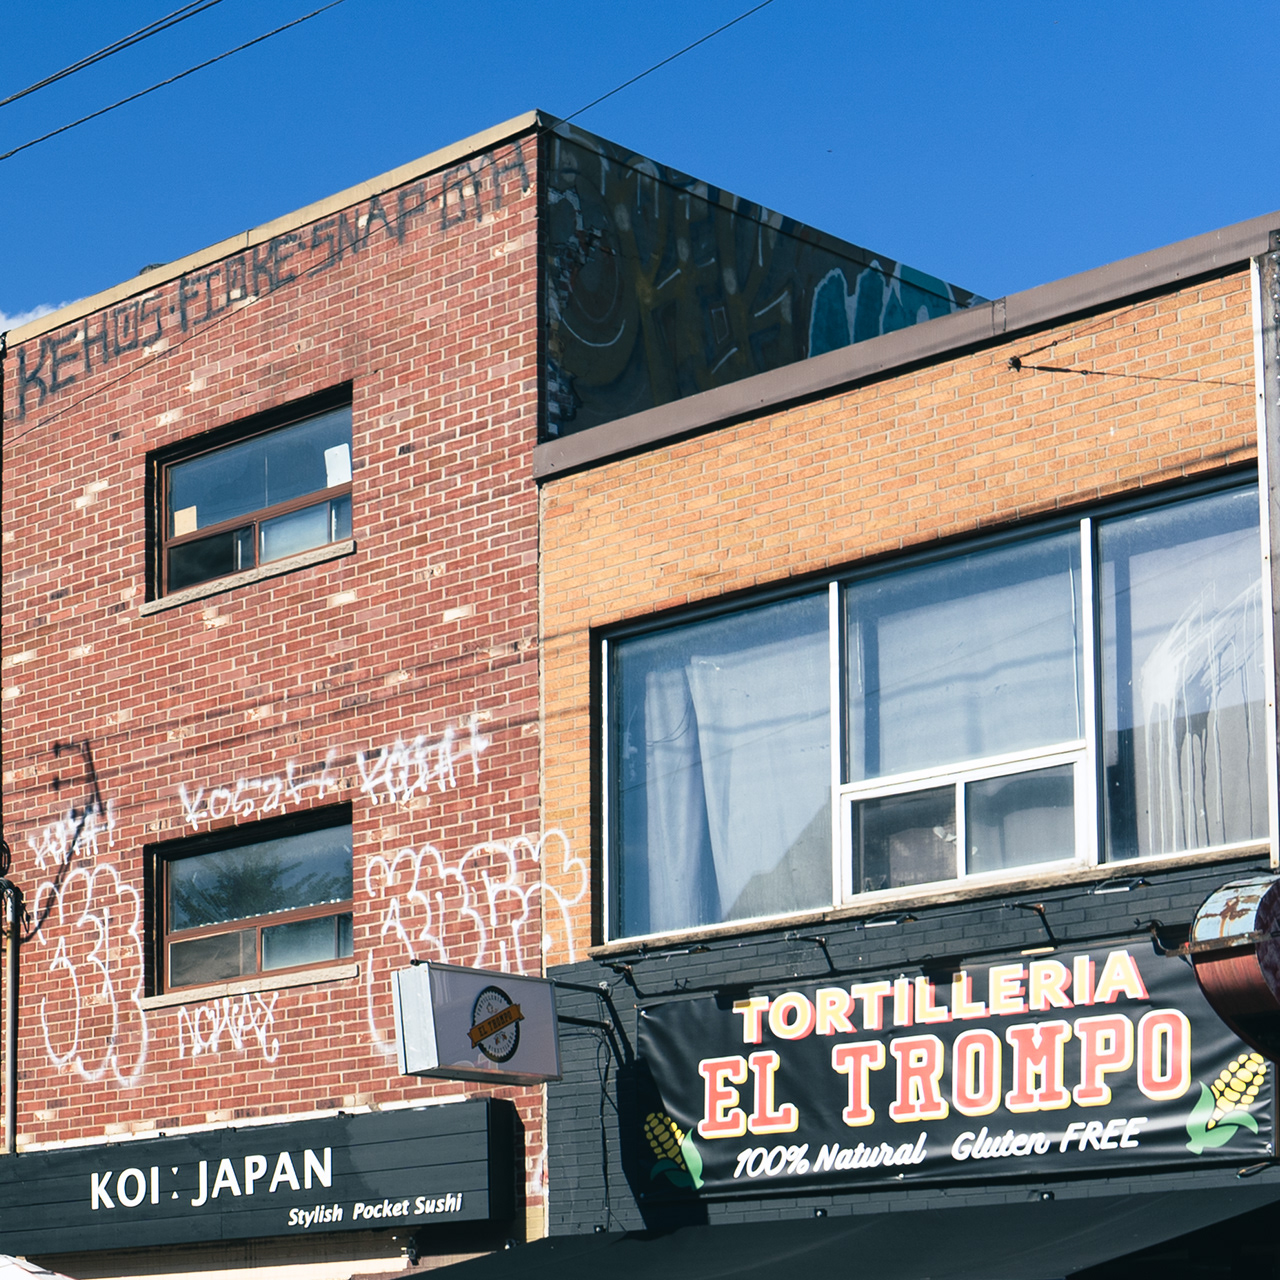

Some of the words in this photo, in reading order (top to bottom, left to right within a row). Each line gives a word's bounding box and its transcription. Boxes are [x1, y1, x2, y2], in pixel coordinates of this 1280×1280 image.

[732, 949, 1150, 1044] TORTILLERIA
[697, 1050, 799, 1139] EL
[831, 1008, 1192, 1128] TROMPO
[191, 1146, 335, 1208] JAPAN
[734, 1143, 811, 1178] 100%
[813, 1131, 927, 1172] Natural
[952, 1124, 1051, 1161] Gluten
[1058, 1116, 1148, 1154] FREE
[288, 1203, 344, 1228] Stylish
[352, 1198, 411, 1222] Pocket
[413, 1191, 463, 1216] Sushi
